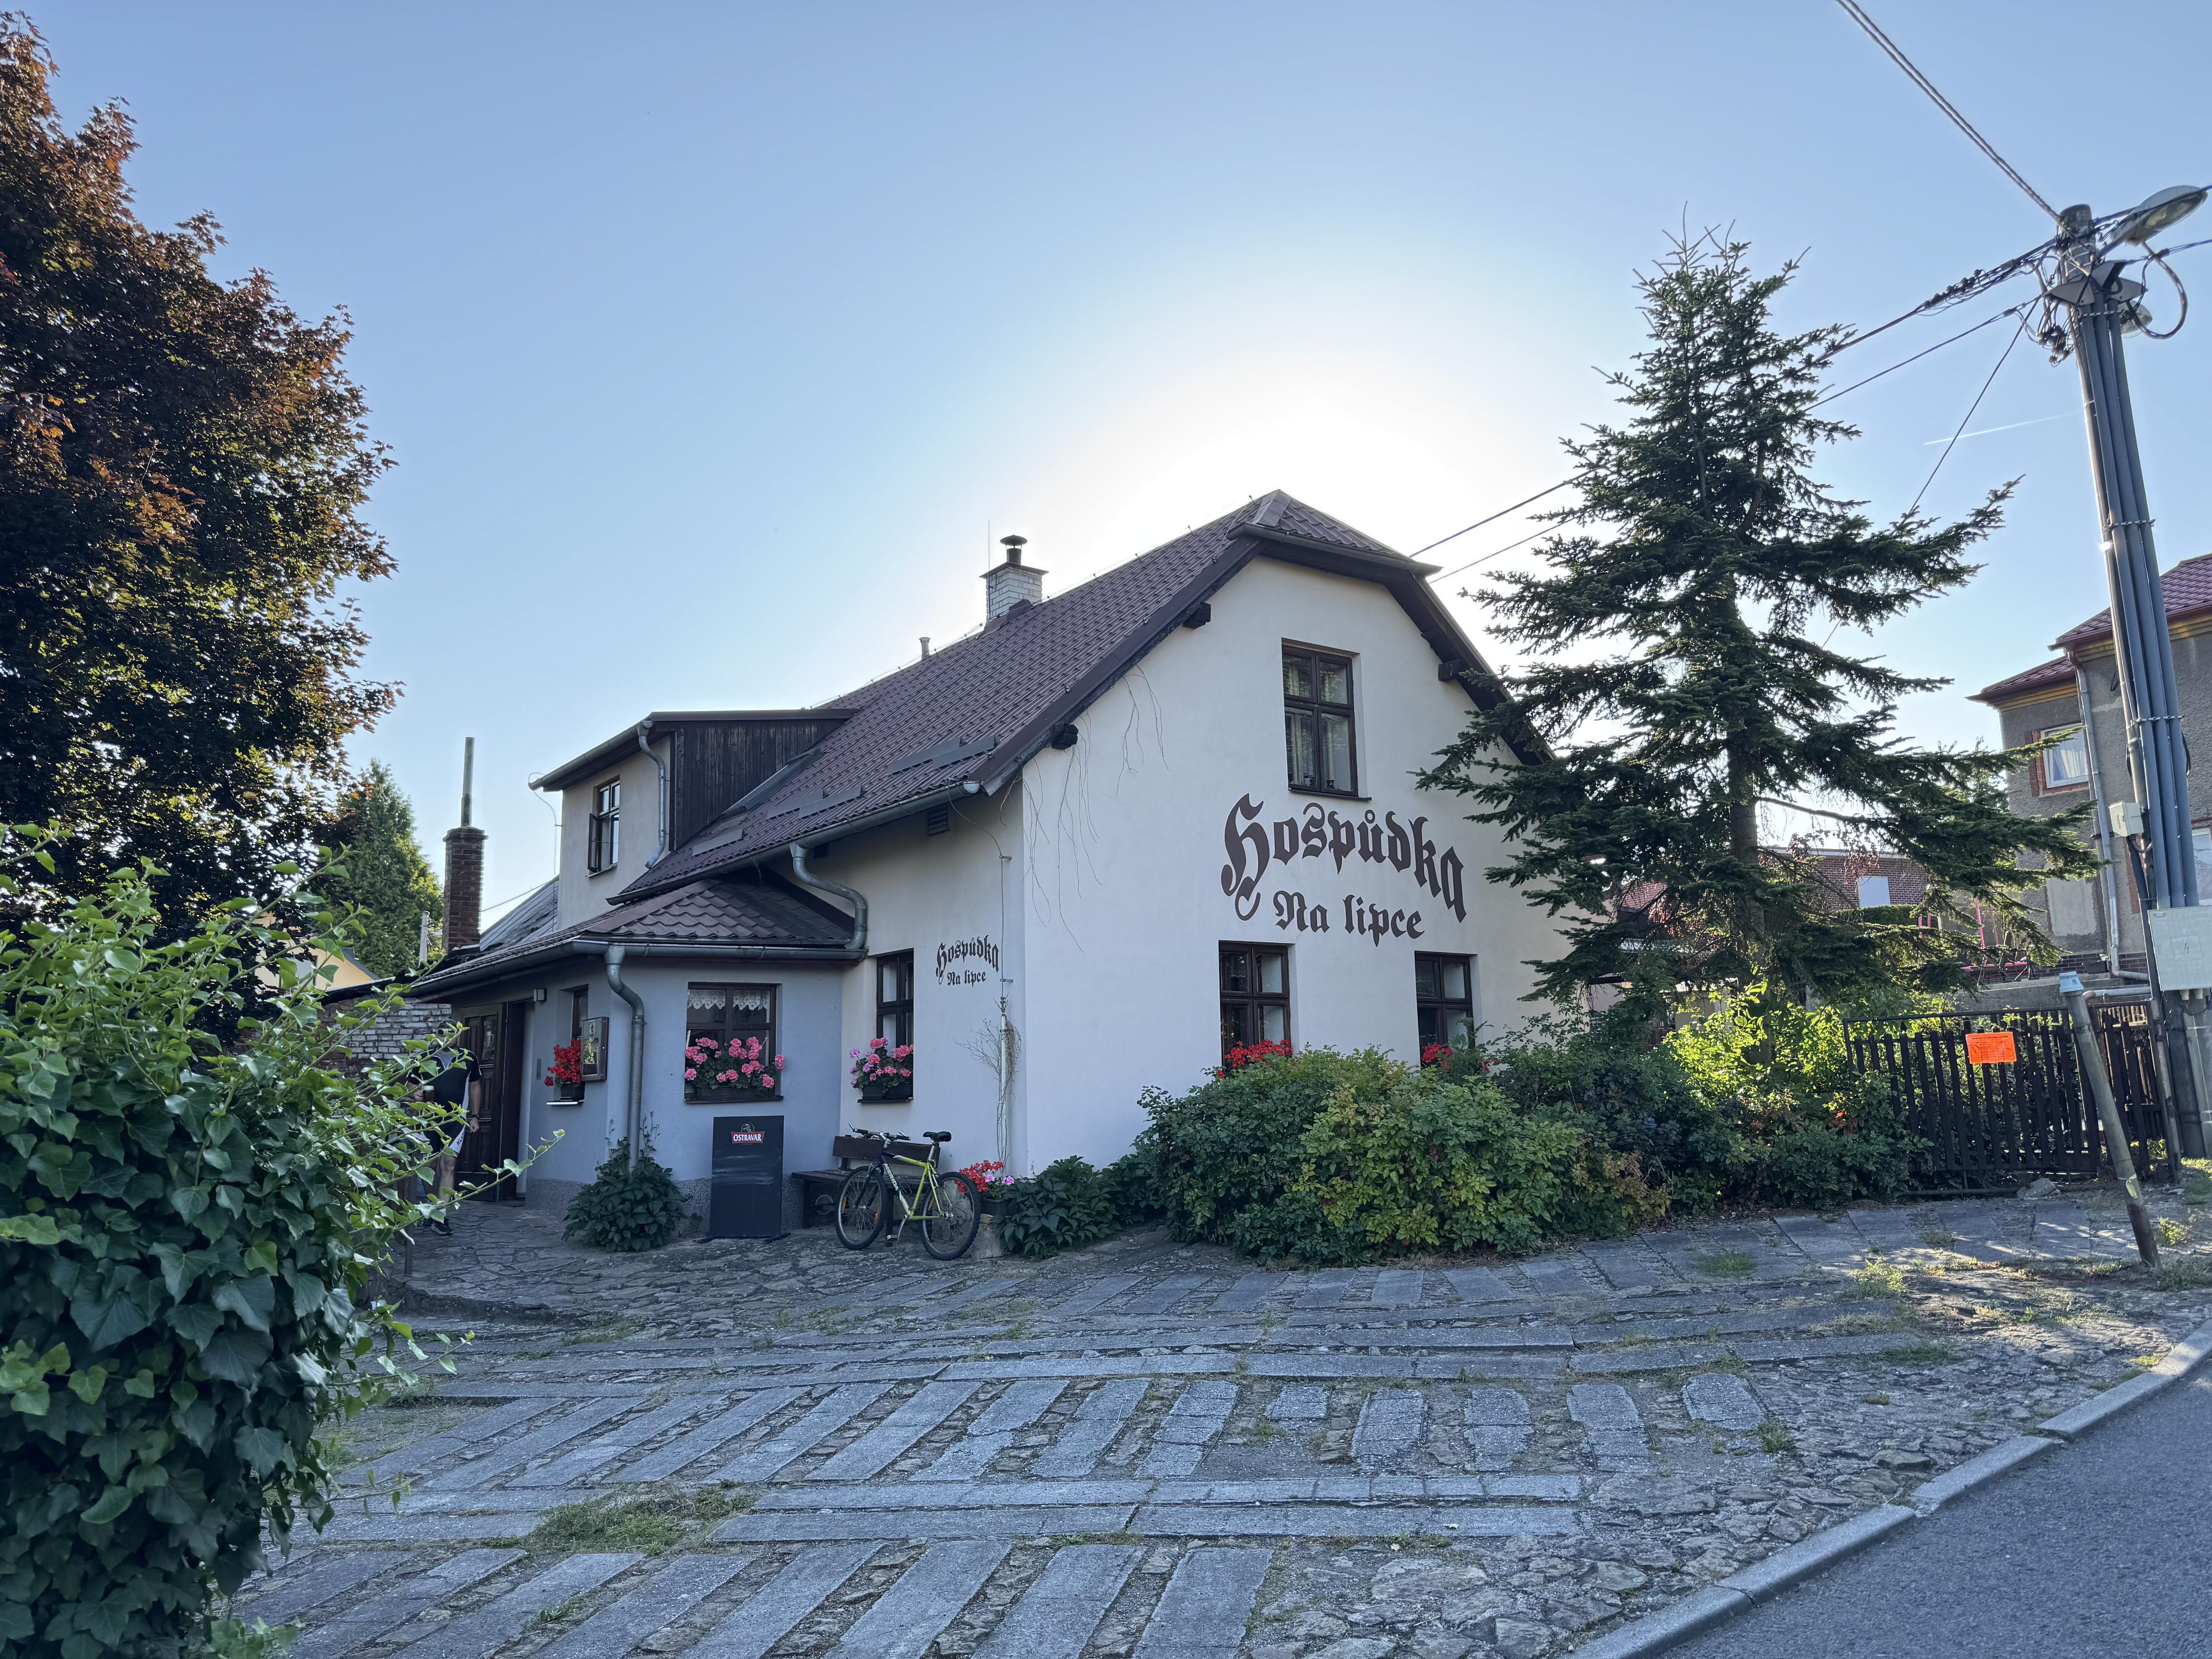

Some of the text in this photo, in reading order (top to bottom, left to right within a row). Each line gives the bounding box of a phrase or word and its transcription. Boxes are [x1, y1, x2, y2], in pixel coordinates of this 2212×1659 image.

[1220, 792, 1467, 924] Hospůdka
[1273, 890, 1425, 947] Na lipce
[936, 935, 999, 985] Hospůdka
[947, 969, 987, 988] Na lipce
[883, 1163, 899, 1191] MERIDA
